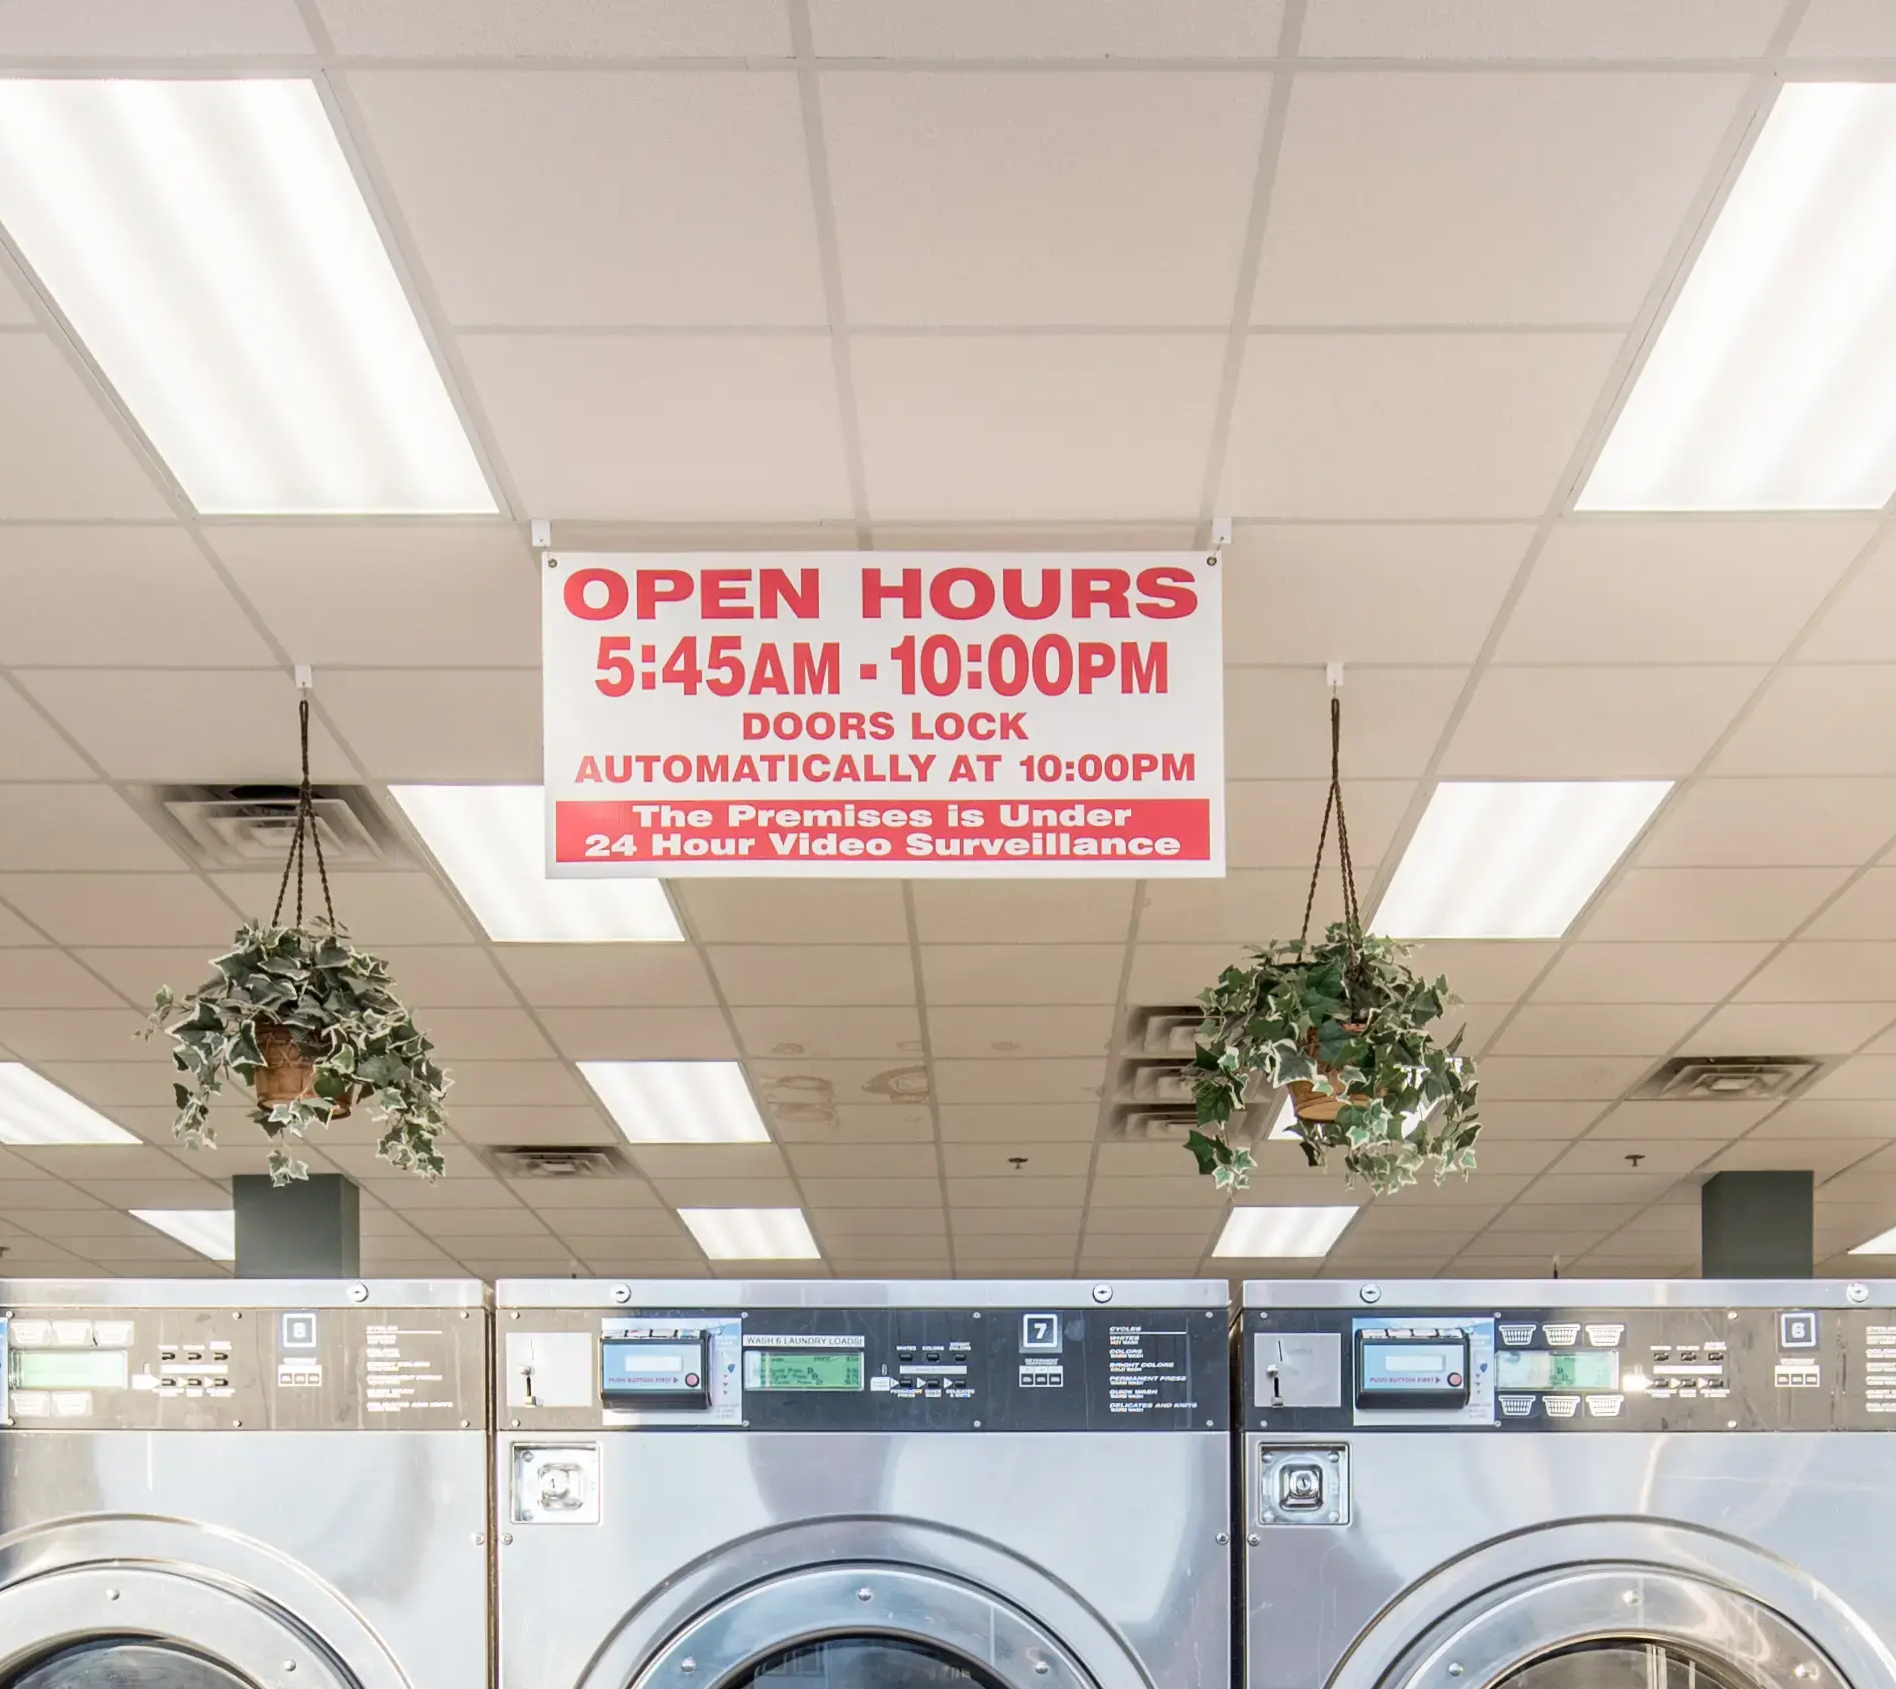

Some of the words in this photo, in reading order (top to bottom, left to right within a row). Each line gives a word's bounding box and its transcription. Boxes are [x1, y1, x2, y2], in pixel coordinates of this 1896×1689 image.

[562, 567, 820, 620] OPEN
[862, 567, 1198, 620] HOURS
[595, 635, 840, 697] 5:45AM
[890, 634, 1168, 697] 10:00PM
[742, 711, 894, 741] DOORS
[912, 711, 1028, 741] LOCK
[574, 754, 937, 783] AUTOMATICALLY
[948, 754, 1002, 783] AT
[1019, 753, 1196, 783] 10:00PM
[633, 804, 713, 828] The
[728, 804, 933, 828] Premises
[948, 804, 983, 828] is
[999, 804, 1132, 828] Under
[585, 833, 637, 857] 24
[651, 833, 755, 857] Hour
[769, 833, 892, 857] Video
[906, 833, 1181, 857] Surveillance
[748, 1336, 774, 1344] WASH
[776, 1336, 781, 1344] 6
[784, 1337, 826, 1345] LAUNDRY
[1034, 1323, 1047, 1340] 7
[1791, 1322, 1805, 1339] 6
